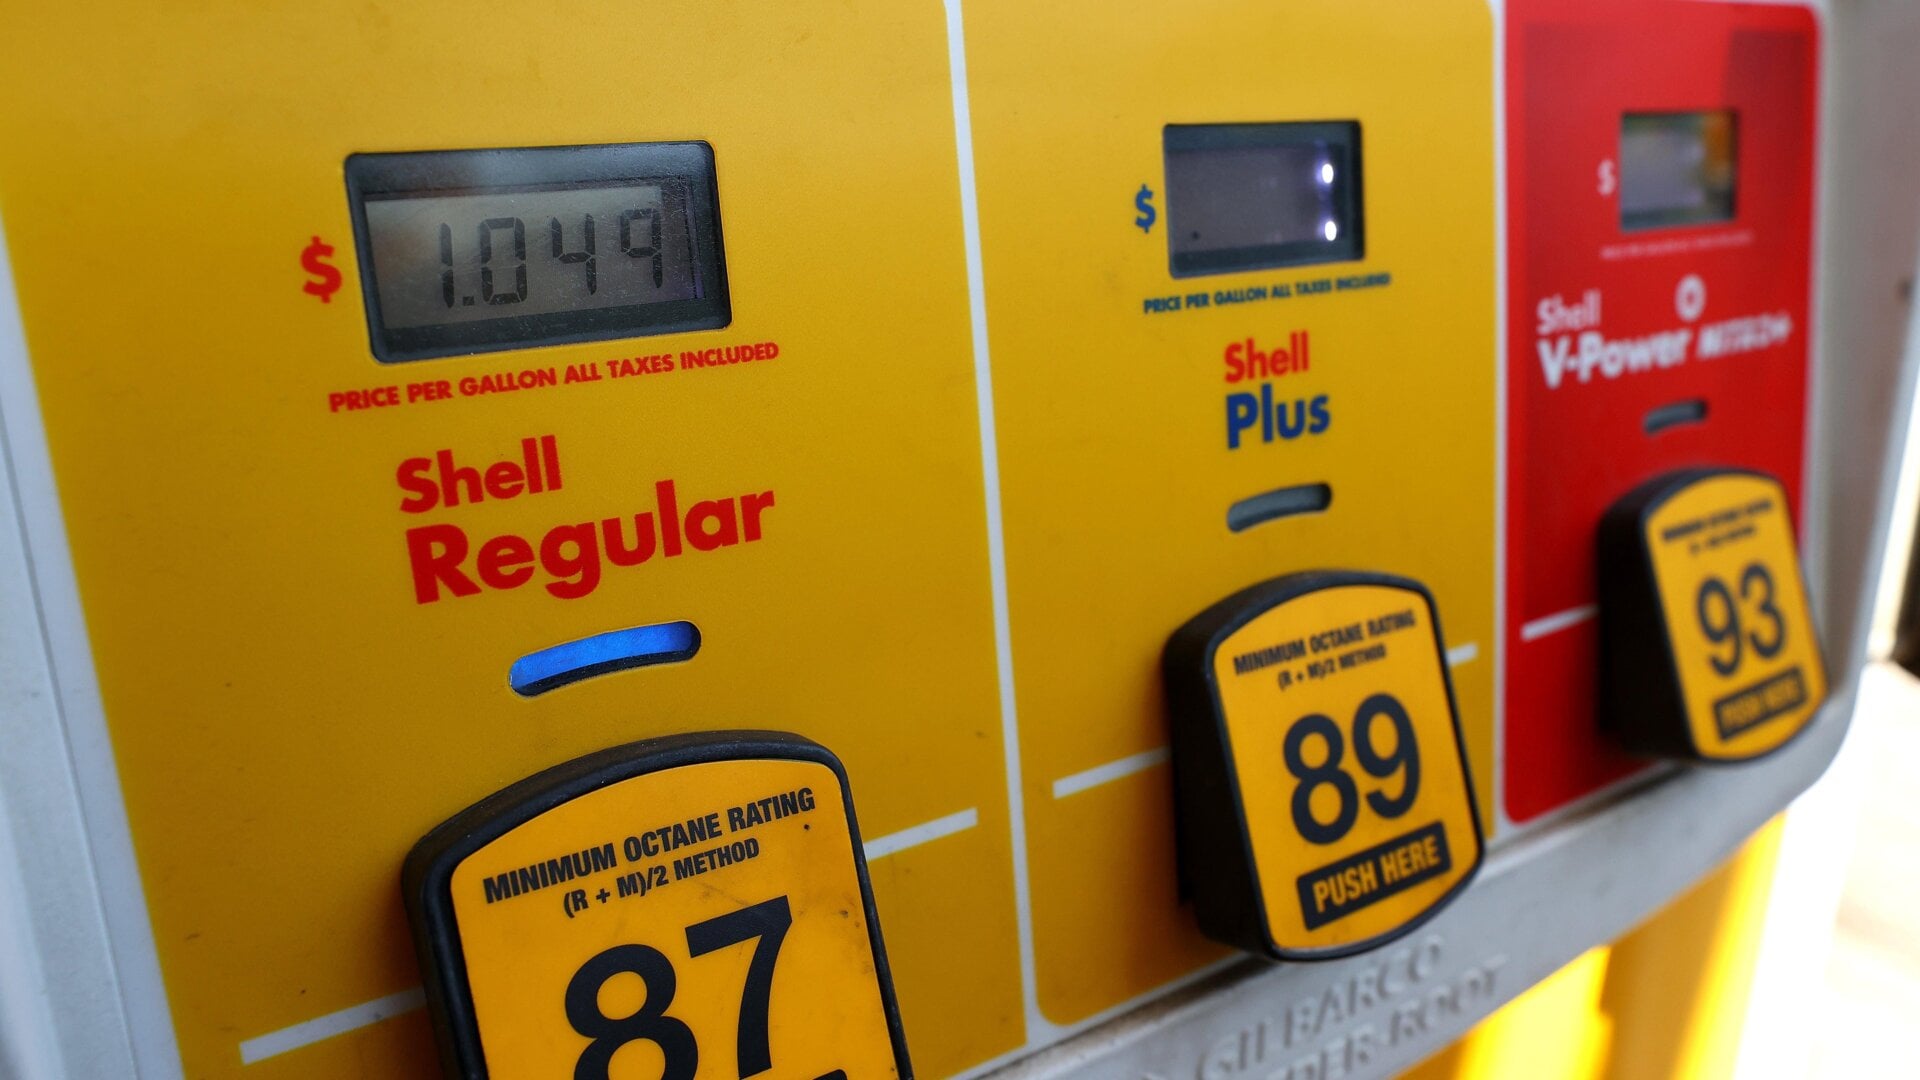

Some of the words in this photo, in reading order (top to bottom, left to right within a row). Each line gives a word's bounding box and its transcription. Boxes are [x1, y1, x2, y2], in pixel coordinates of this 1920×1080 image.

[1135, 184, 1156, 233] $
[301, 236, 342, 303] $
[440, 208, 663, 308] 1.049
[1144, 295, 1181, 314] PRICE
[1186, 292, 1210, 309] PER
[1214, 287, 1267, 306] GALLON
[1271, 283, 1292, 298] ALL
[1537, 288, 1600, 335] Shell
[328, 386, 400, 412] PRICE
[407, 380, 452, 403] PER
[459, 367, 556, 396] GALLON
[564, 362, 602, 385] ALL
[607, 353, 674, 379] TAXES
[680, 342, 780, 369] INCLUDED
[1224, 330, 1309, 384] Shell
[1537, 327, 1692, 389] V-Power
[1226, 382, 1331, 450] Plus
[395, 434, 562, 514] Shell
[406, 479, 775, 605] Regular
[1233, 638, 1306, 676] MINIMUM
[1309, 623, 1364, 654] OCTANE
[1367, 609, 1415, 636] RATING
[1697, 562, 1786, 677] 93
[1283, 692, 1421, 845] 89
[483, 842, 617, 904] MINIMUM
[624, 813, 722, 862] OCTANE
[727, 787, 815, 833] RATING
[563, 889, 589, 918] (R
[596, 888, 611, 904] +
[616, 865, 669, 897] M)/2
[673, 837, 760, 881] METHOD
[1313, 861, 1378, 913] PUSH
[1380, 834, 1441, 885] HERE
[564, 894, 793, 1080] 87
